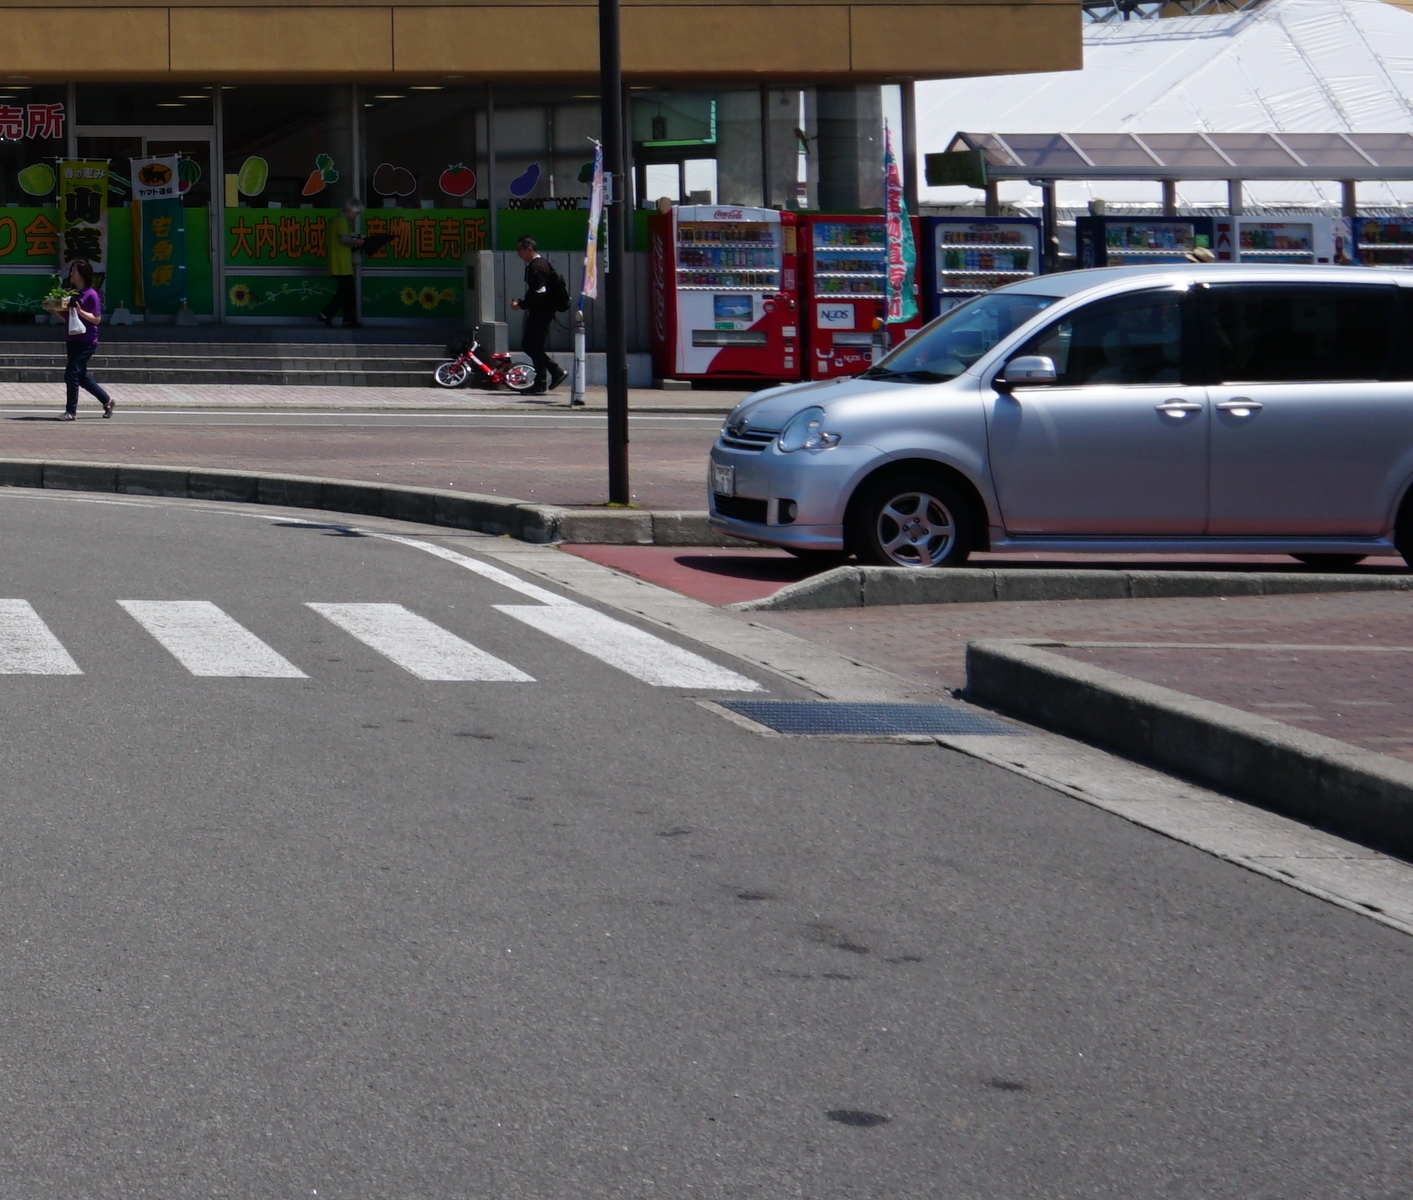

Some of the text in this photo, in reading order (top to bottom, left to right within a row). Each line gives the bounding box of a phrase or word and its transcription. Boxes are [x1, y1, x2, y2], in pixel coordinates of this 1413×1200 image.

[150, 216, 174, 287] 宅急便
[230, 216, 488, 259] 大内地域産物直売所
